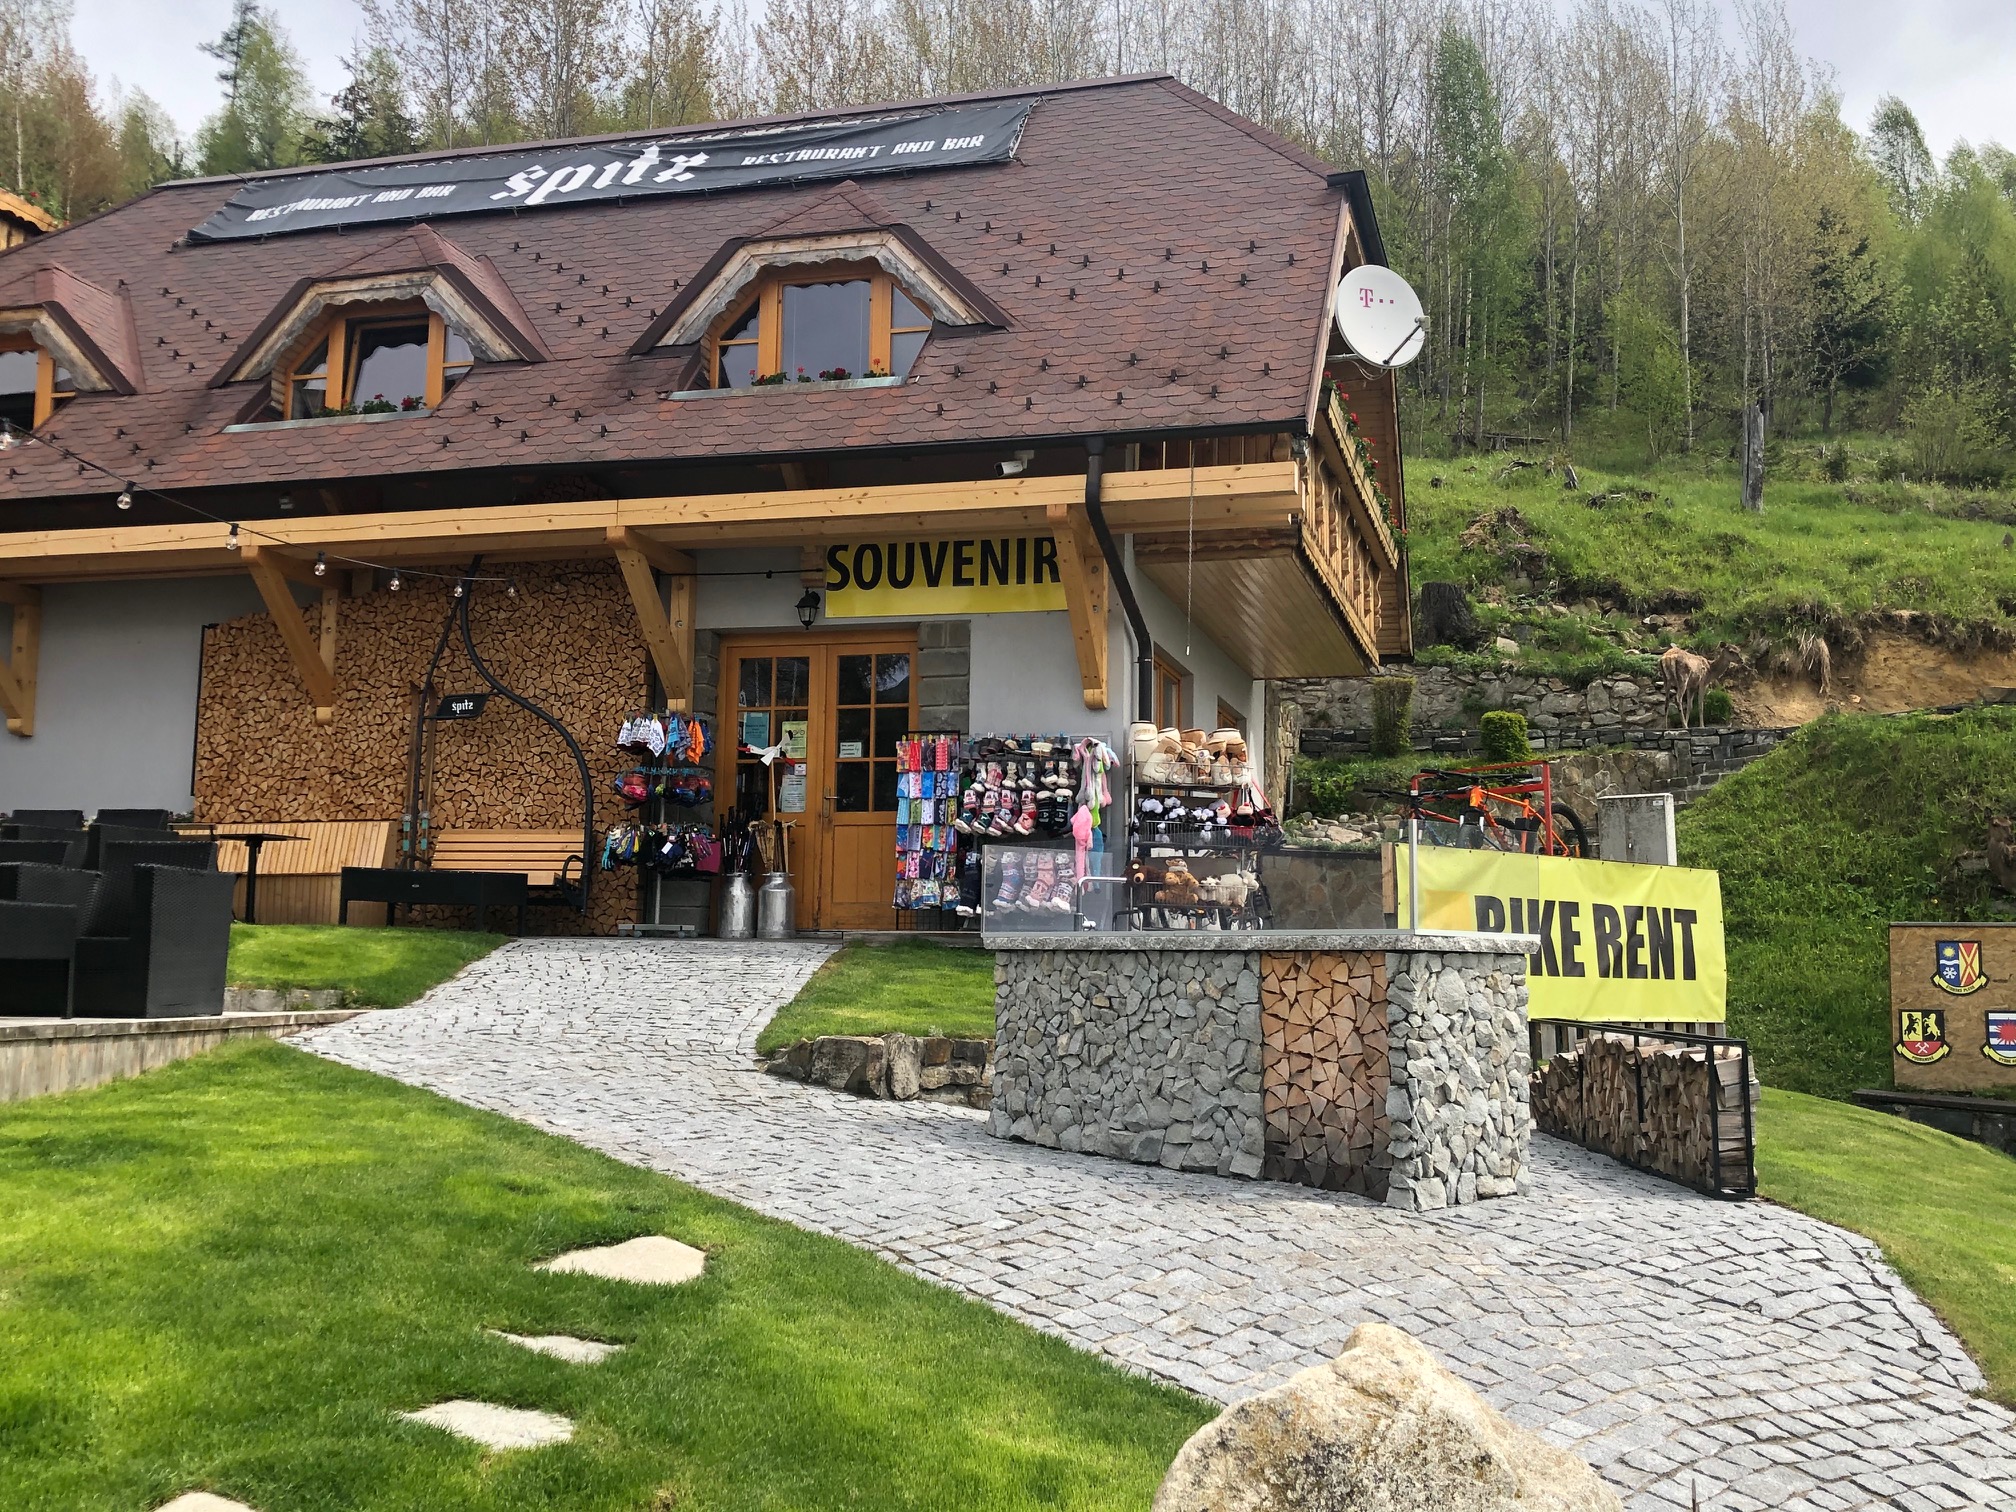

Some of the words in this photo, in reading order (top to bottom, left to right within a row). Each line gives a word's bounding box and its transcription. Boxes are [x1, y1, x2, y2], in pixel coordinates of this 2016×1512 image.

[740, 144, 887, 166] RESTAURANT
[890, 140, 937, 155] AND
[941, 134, 985, 151] BAR
[245, 193, 373, 222] RESTAURANT
[370, 188, 415, 204] AND
[414, 185, 457, 199] BAR
[826, 536, 1062, 591] SOUVENIR
[1592, 903, 1698, 981] RENT
